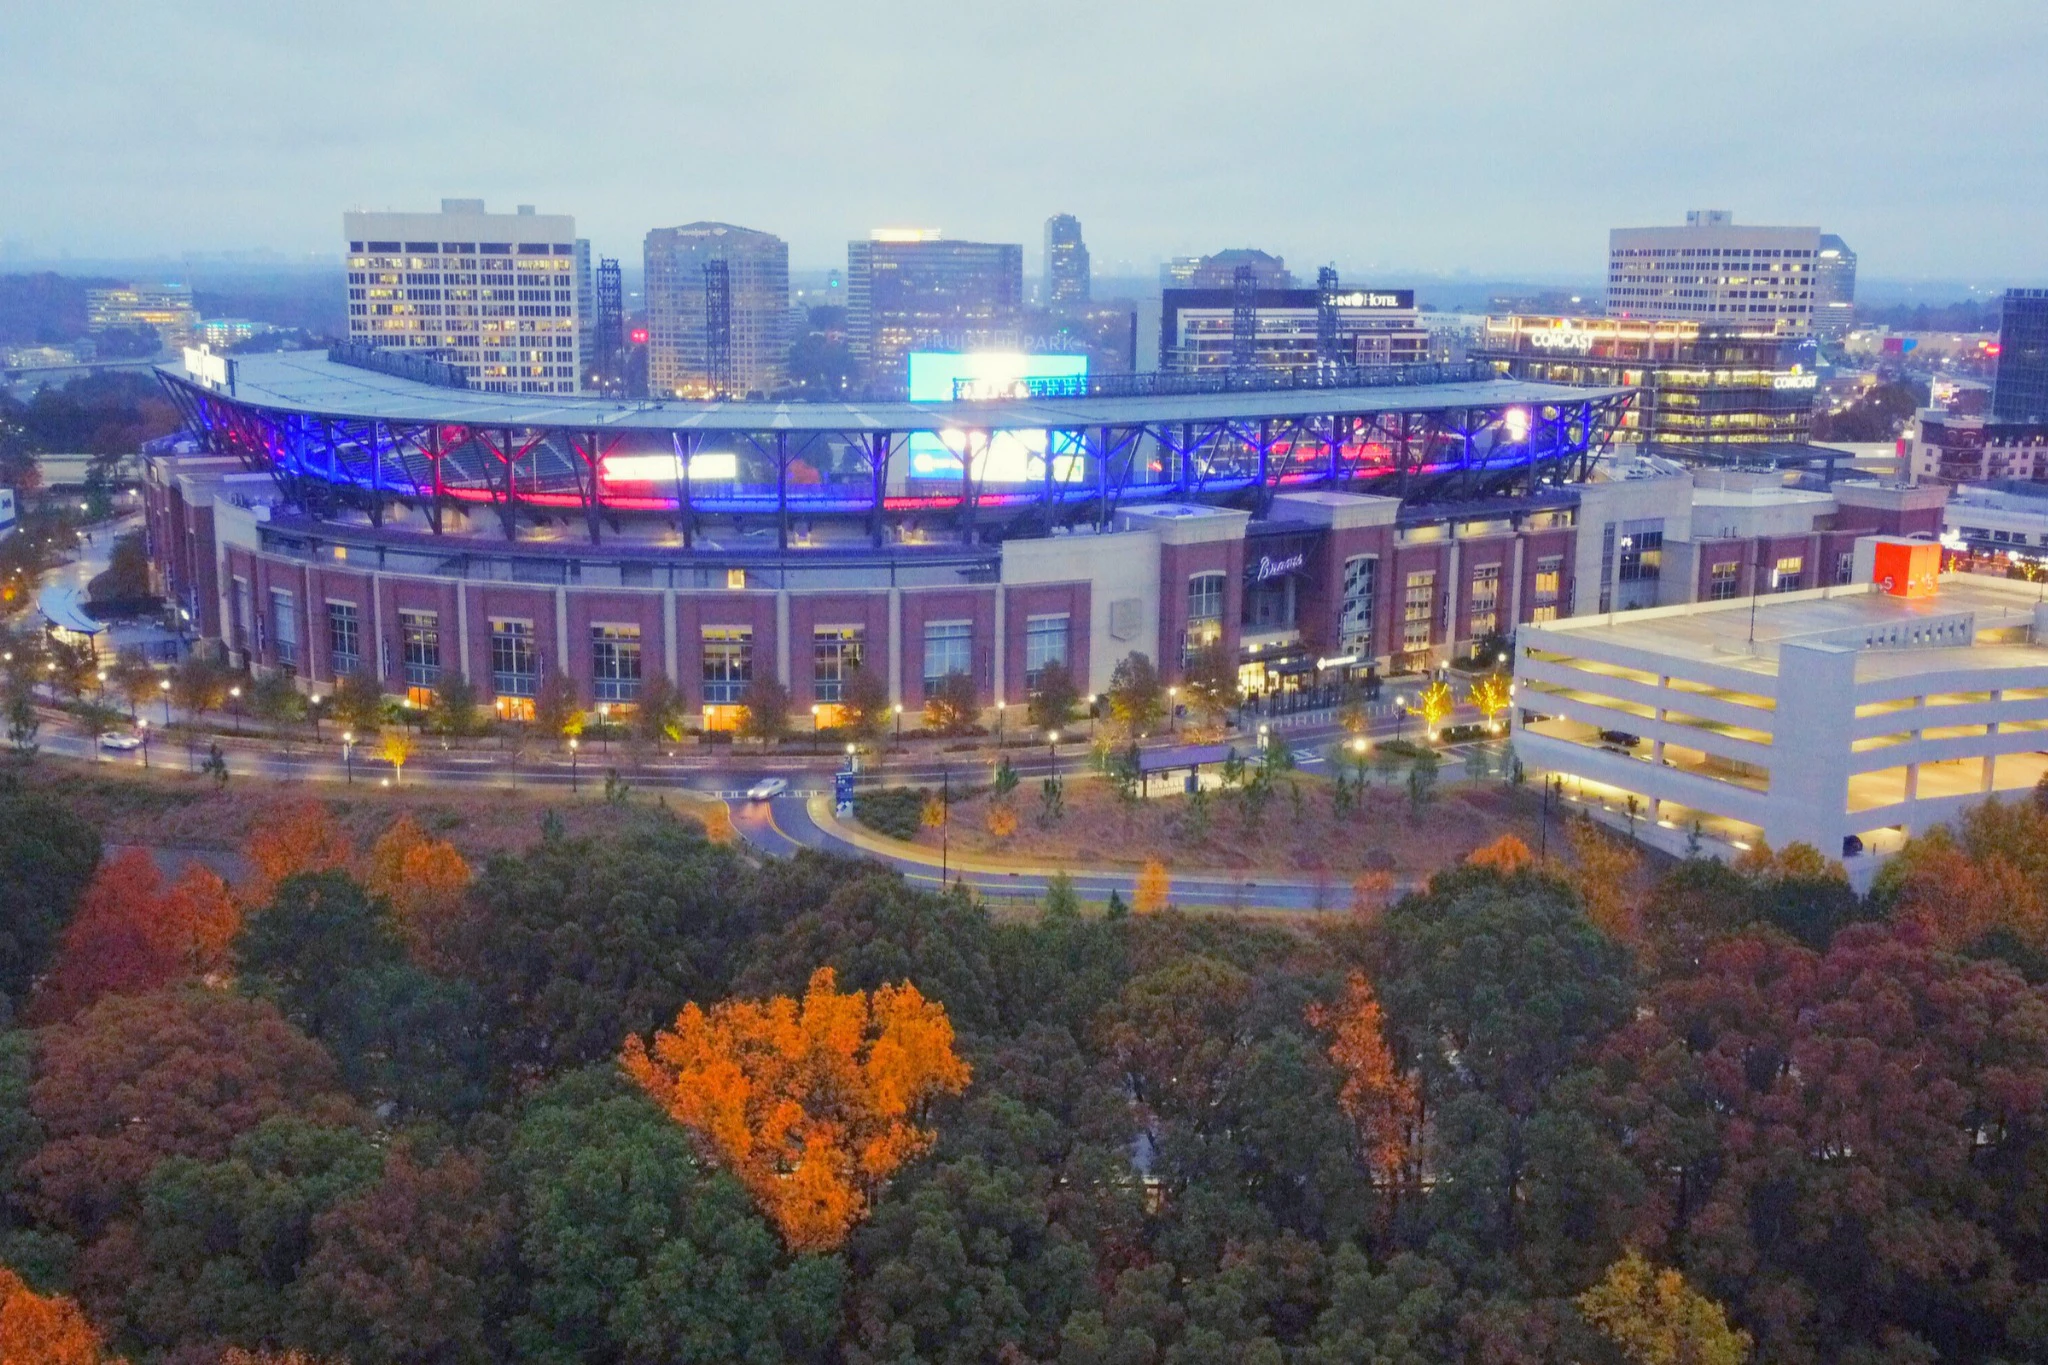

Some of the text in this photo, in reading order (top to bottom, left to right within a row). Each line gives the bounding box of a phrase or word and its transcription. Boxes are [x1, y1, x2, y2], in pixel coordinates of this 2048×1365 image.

[1364, 293, 1398, 306] HOTEL
[922, 334, 1075, 351] TRUIST PARK
[1531, 333, 1593, 350] COMCAST
[1774, 375, 1818, 389] COMCAST
[1883, 576, 1893, 590] 5
